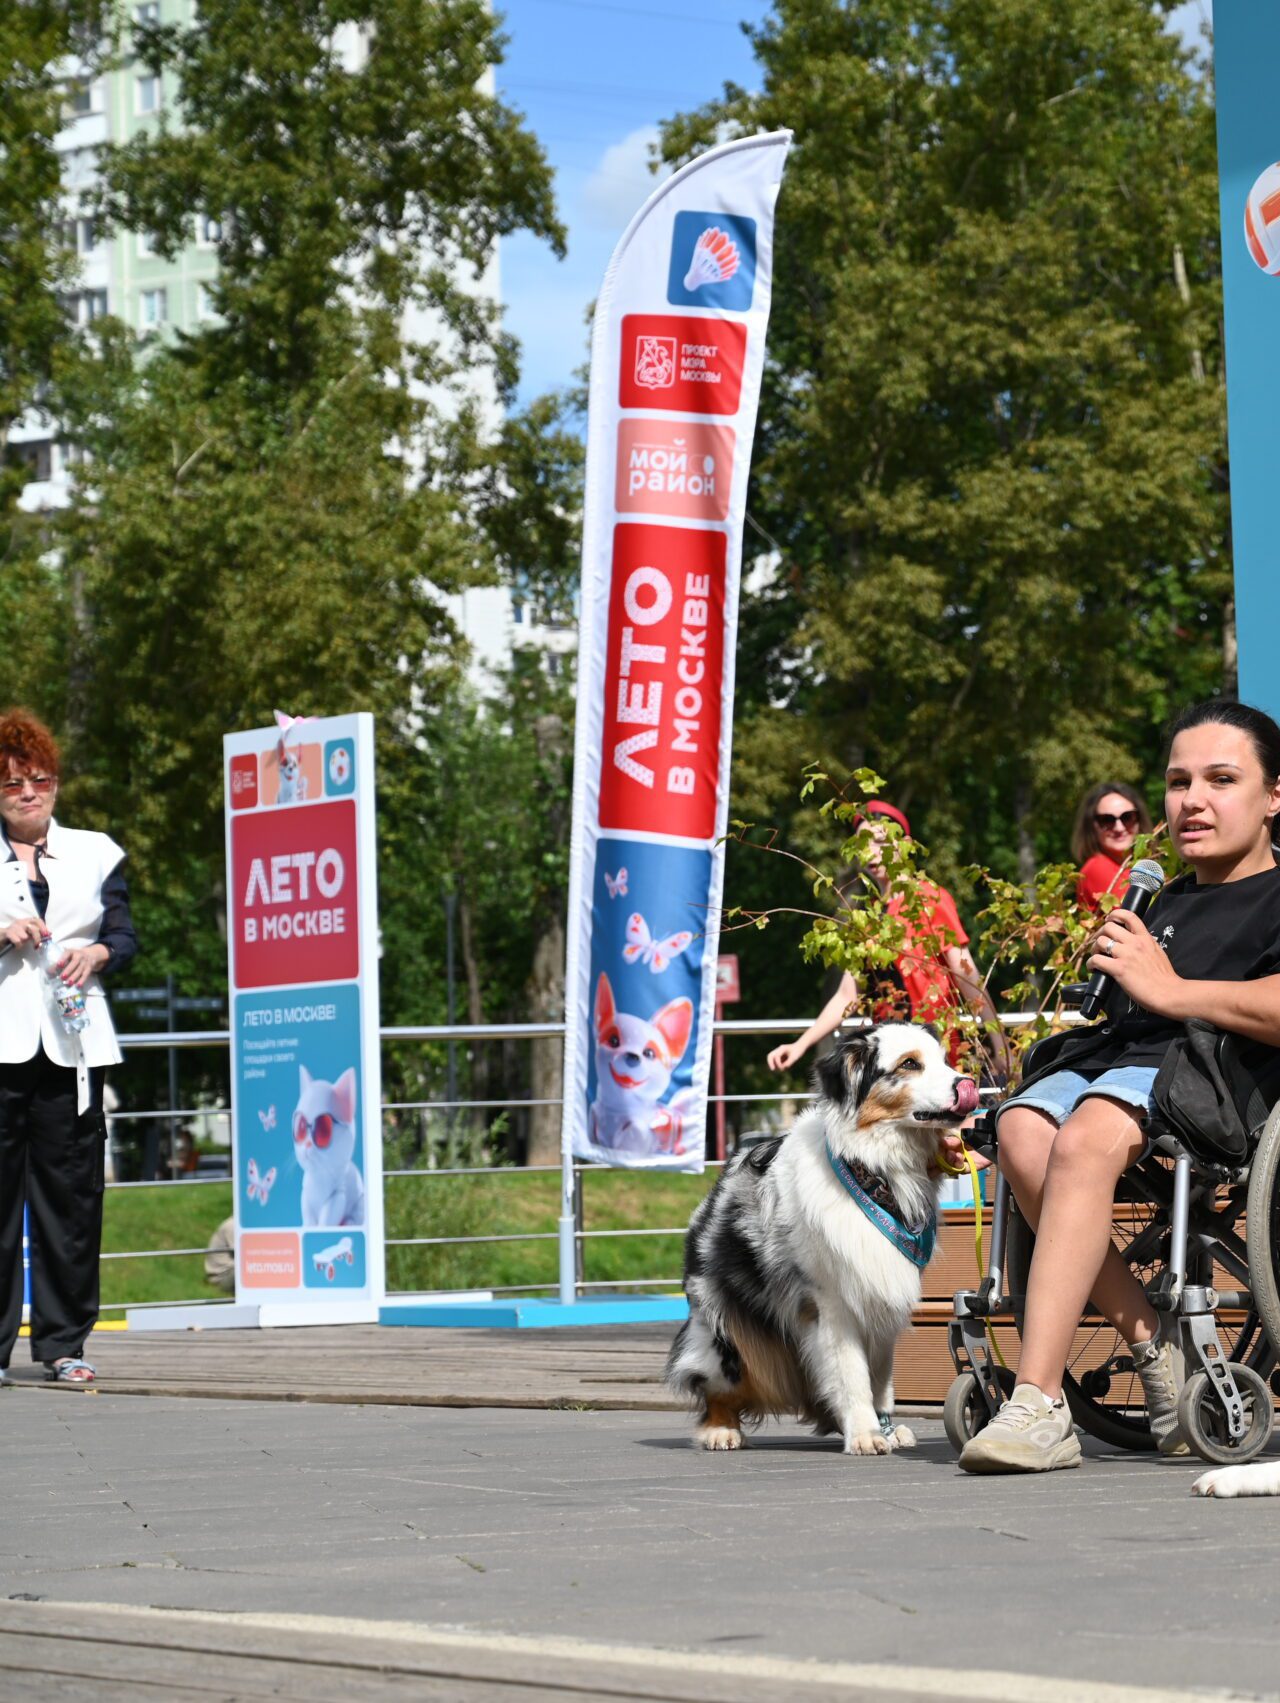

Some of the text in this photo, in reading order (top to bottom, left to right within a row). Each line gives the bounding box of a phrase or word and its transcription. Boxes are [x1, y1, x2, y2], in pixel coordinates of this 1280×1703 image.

[681, 344, 718, 357] ПРОЕКТ
[681, 356, 706, 368] МЭРА
[680, 369, 722, 383] МОСКВЫ
[613, 566, 673, 789] ЛЕТО
[666, 572, 710, 795] В МОСКВЕ
[244, 847, 345, 907] ЛЕТО
[244, 907, 346, 943] В МОСКВЕ
[243, 1009, 272, 1027] ЛЕТО
[274, 1008, 283, 1024] В
